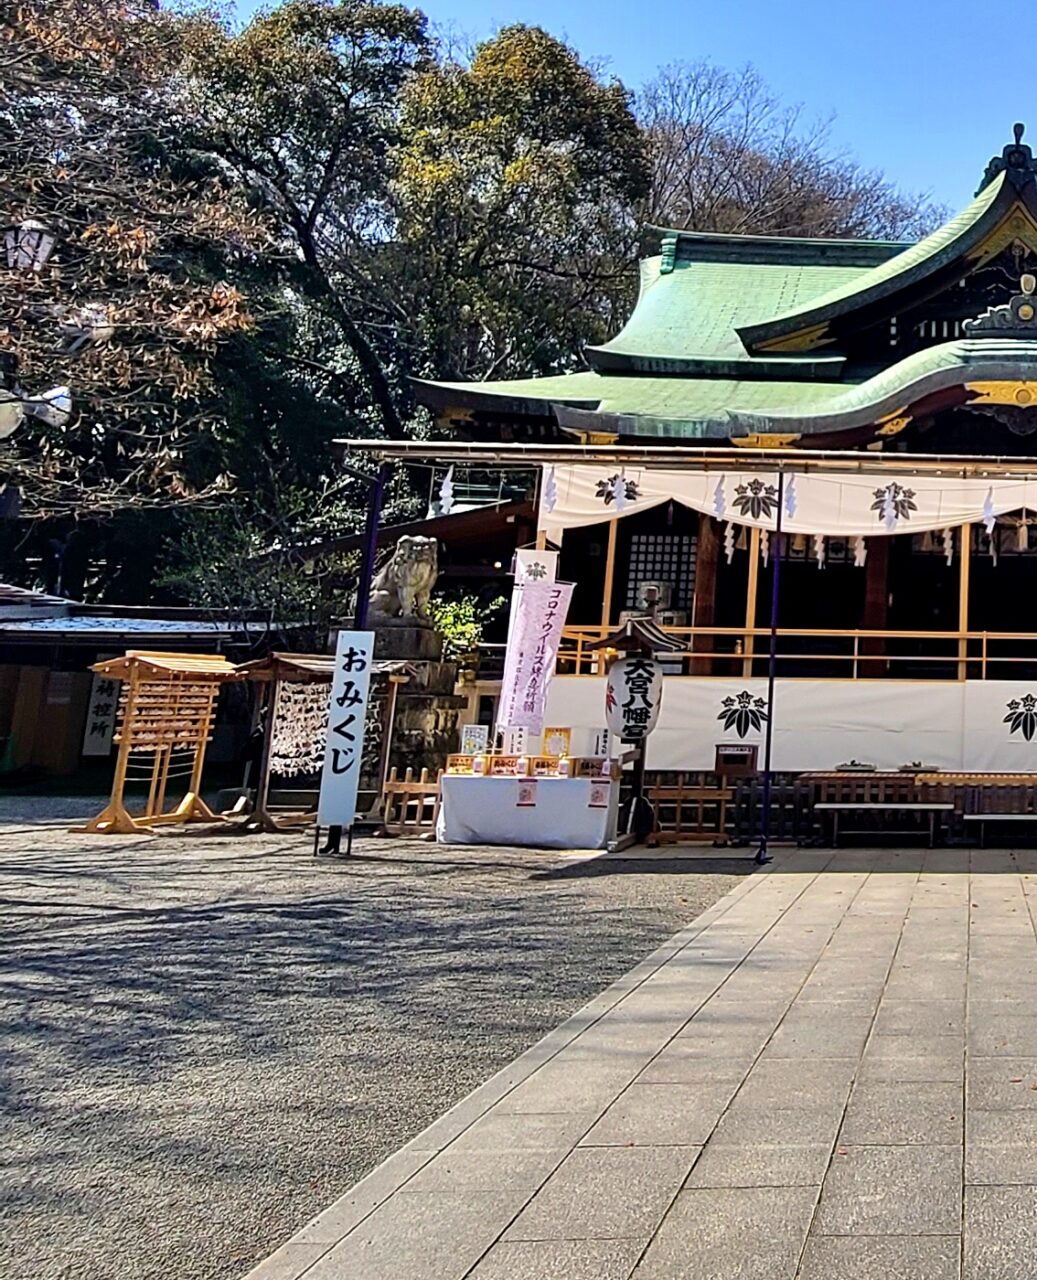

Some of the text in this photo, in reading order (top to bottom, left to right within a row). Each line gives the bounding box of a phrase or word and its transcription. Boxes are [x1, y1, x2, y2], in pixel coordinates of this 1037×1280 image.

[331, 646, 367, 775] おみくじ
[621, 659, 656, 738] 大宮八幡宮
